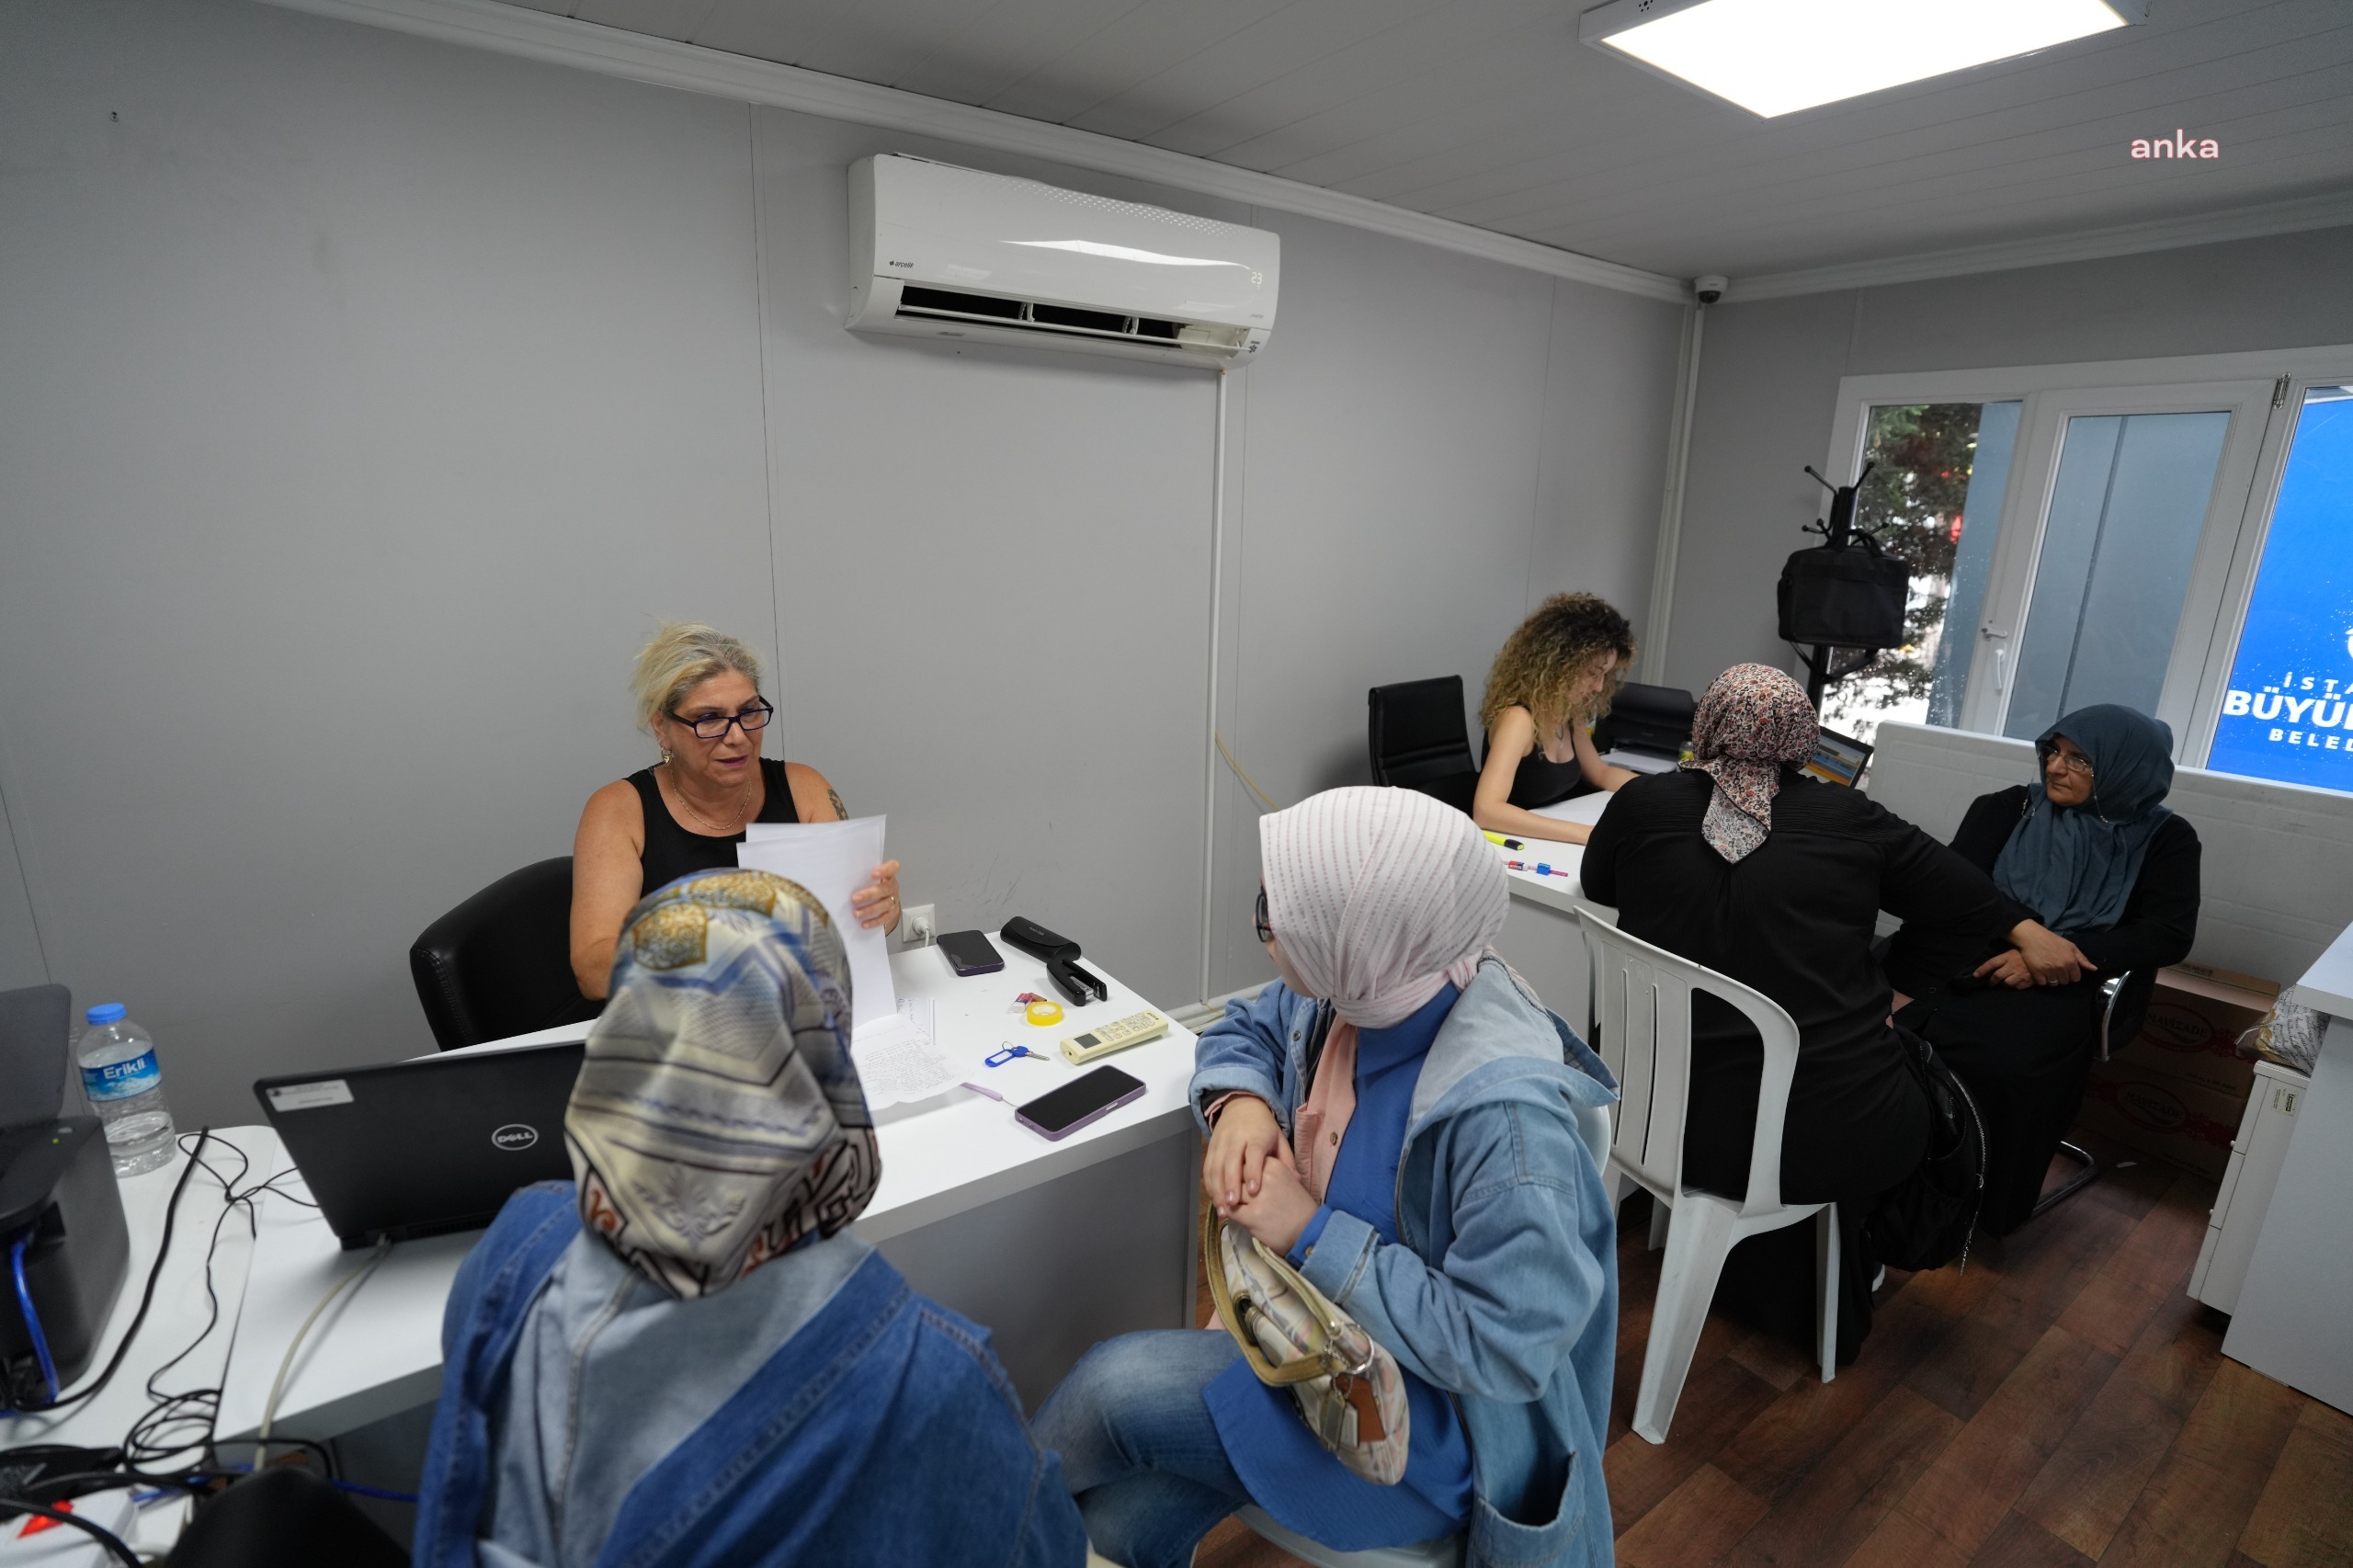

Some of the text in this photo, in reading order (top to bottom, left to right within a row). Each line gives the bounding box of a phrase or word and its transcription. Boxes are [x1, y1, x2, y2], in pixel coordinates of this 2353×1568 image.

[1251, 271, 1263, 284] 23
[103, 1058, 145, 1079] Erikli
[497, 1131, 533, 1143] DELL
